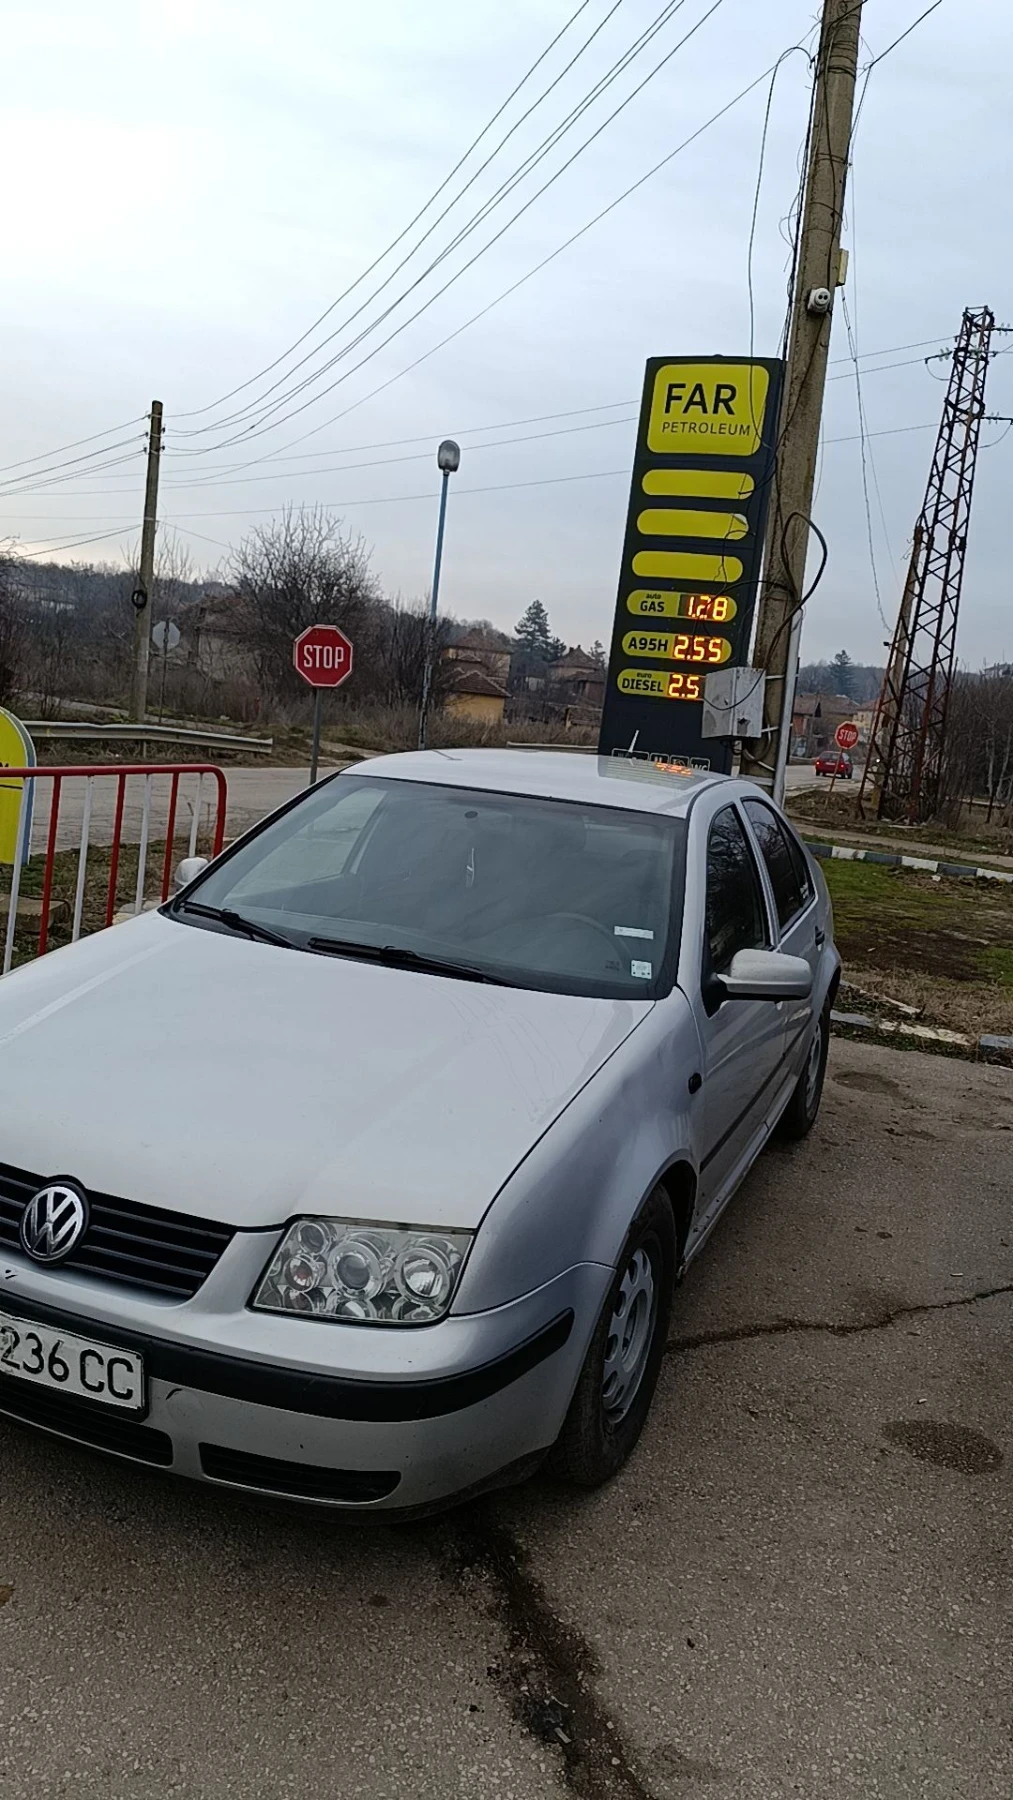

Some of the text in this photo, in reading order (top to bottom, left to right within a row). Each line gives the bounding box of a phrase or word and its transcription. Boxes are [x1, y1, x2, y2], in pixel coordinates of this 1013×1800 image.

[664, 383, 737, 416] FAR
[662, 421, 750, 436] PETROLEUM
[640, 595, 728, 620] GAS 1.28
[645, 592, 662, 600] auto
[303, 644, 344, 669] STOP
[628, 636, 722, 662] A95H 2.55
[621, 674, 700, 698] DIESEL 2.5
[838, 729, 857, 741] STOP
[0, 1325, 134, 1400] 236 CC
